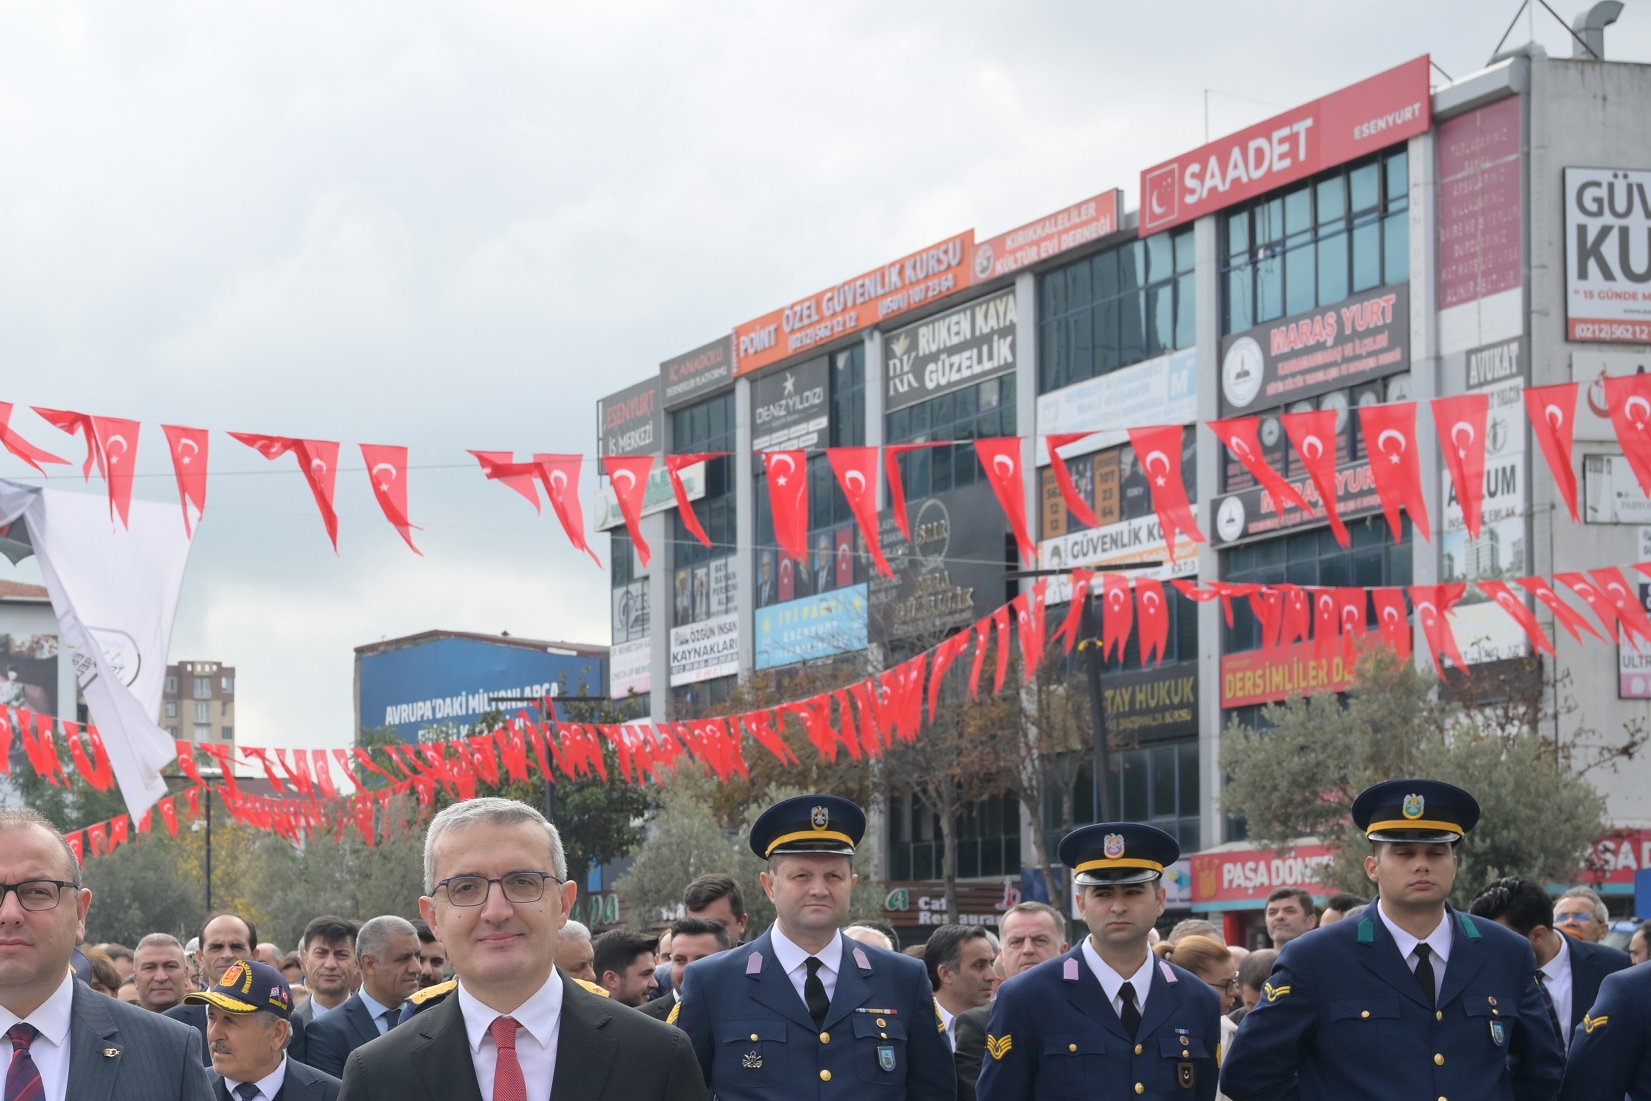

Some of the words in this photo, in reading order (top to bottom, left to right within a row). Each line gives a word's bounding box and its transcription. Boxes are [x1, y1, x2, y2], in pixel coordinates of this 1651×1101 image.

[1353, 102, 1421, 141] ESENYURT
[1183, 116, 1314, 205] SAADET
[995, 243, 1040, 275] KÜLTÜR
[1040, 237, 1060, 261] EVİ
[1061, 214, 1111, 253] DERNEĞİ
[1005, 201, 1097, 251] KIRIKKALELİLER
[782, 297, 820, 333] ÖZEL
[822, 262, 903, 317] GÜVENLİK
[904, 238, 962, 281] KURSU
[1598, 288, 1638, 301] GÜNDE
[917, 309, 972, 357] RUKEN
[974, 293, 1017, 337] KAYA
[1270, 311, 1337, 356] MARAŞ
[1341, 293, 1396, 335] YURT
[924, 334, 1014, 390] GÜZELLİK
[1469, 341, 1519, 386] AVUKAT
[1071, 522, 1142, 560] GÜVENLİK
[672, 639, 737, 664] KAYNAKLARI
[690, 624, 716, 643] ÖZGÜN
[1136, 676, 1194, 707] HUKUK
[1225, 655, 1329, 699] DERSİMLİLER
[385, 691, 466, 726] AVRUPA'DAKİ
[1223, 859, 1270, 895] PAŞA
[1581, 841, 1638, 877] AŞA
[918, 896, 948, 911] Caf
[919, 911, 1002, 926] Resauran
